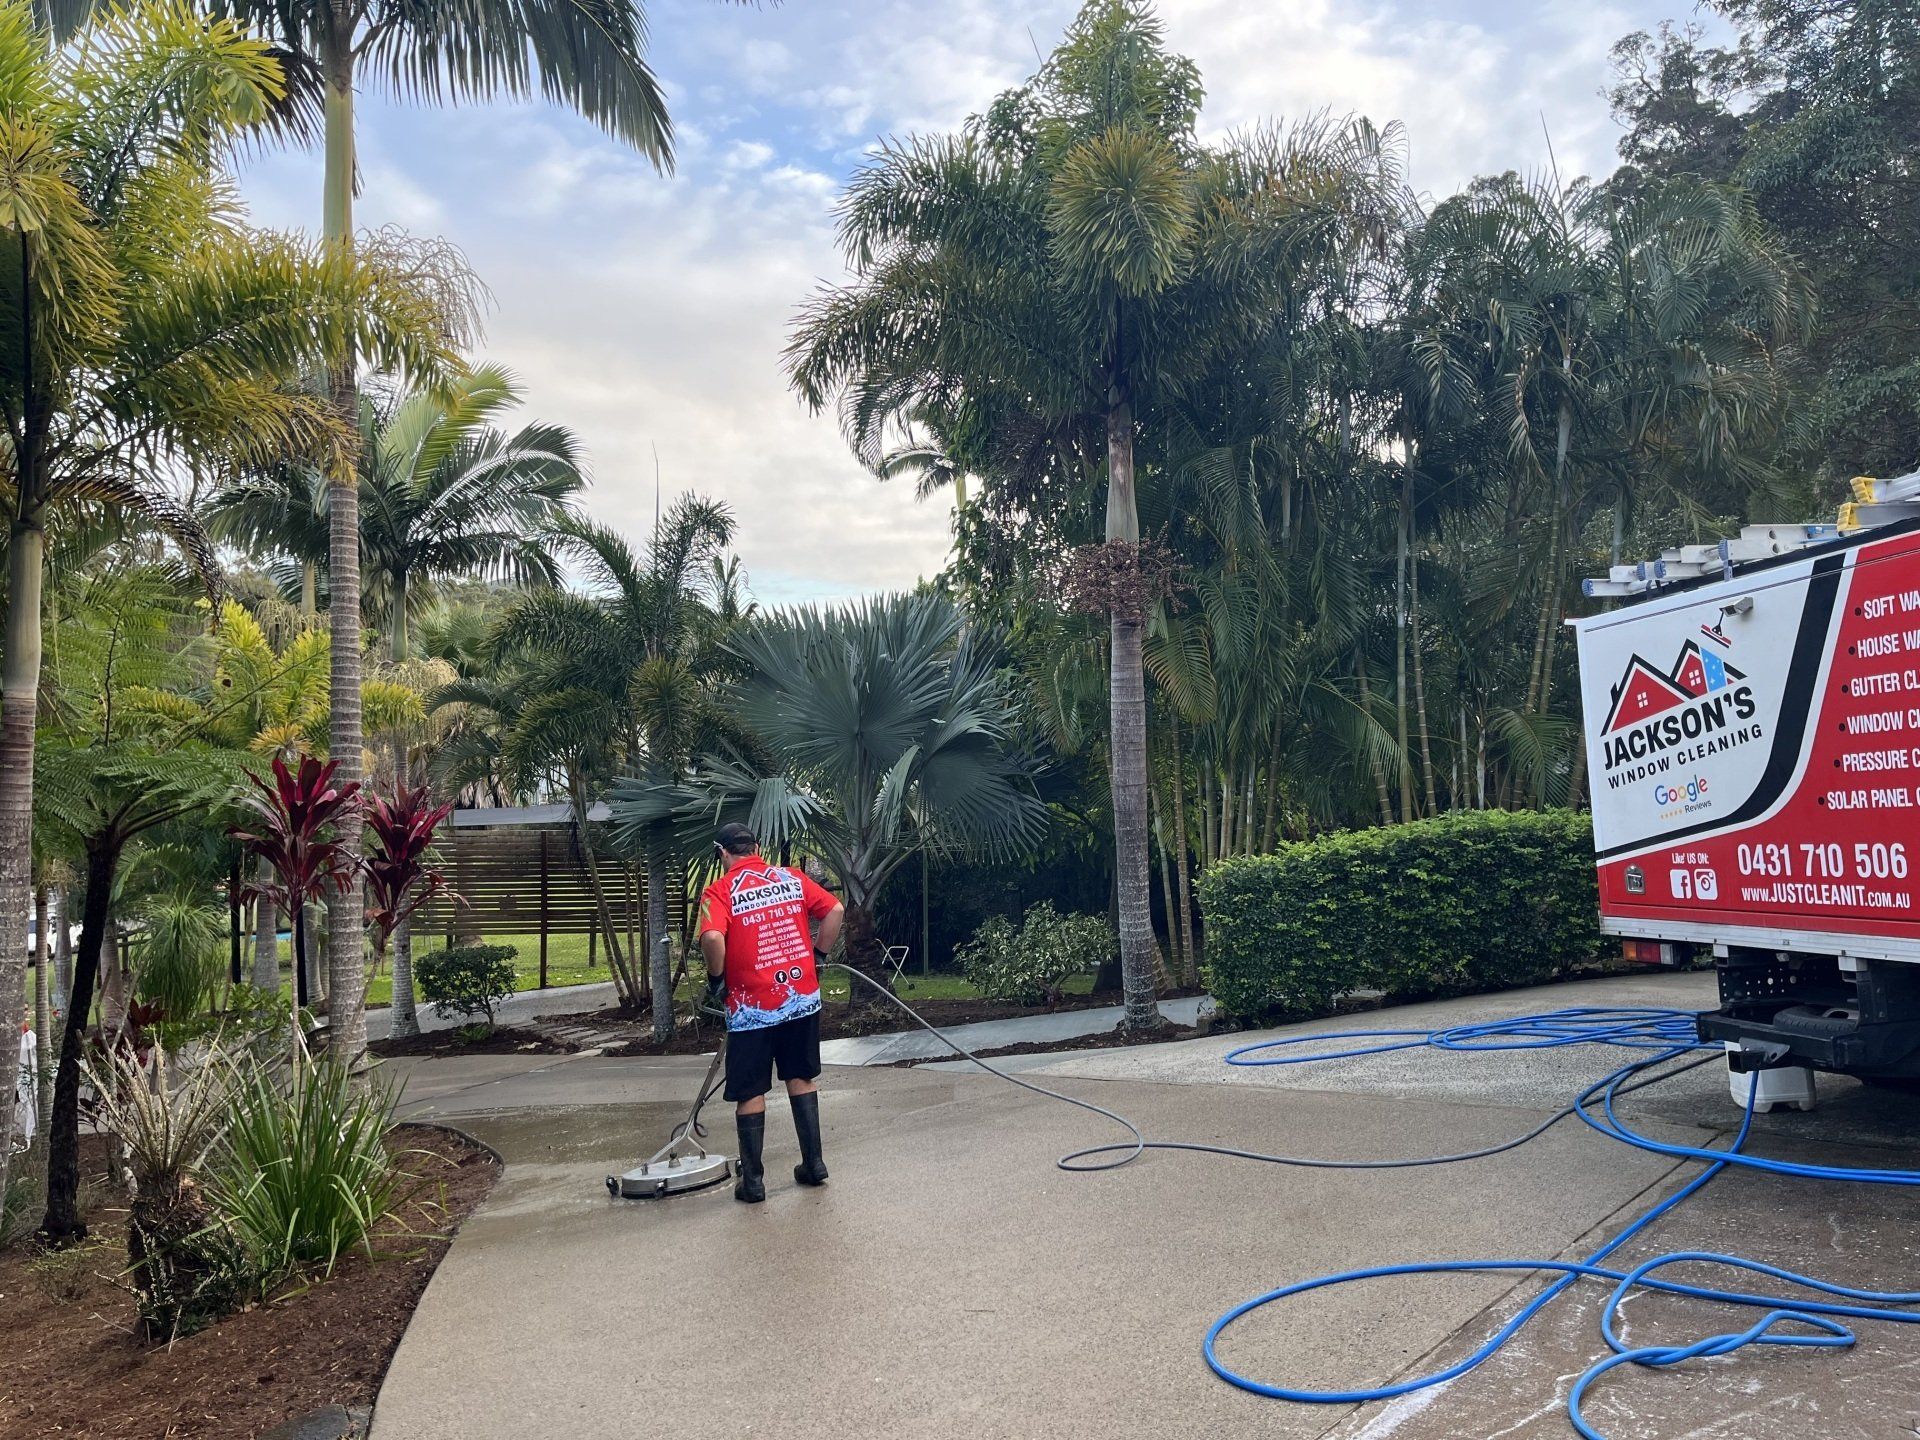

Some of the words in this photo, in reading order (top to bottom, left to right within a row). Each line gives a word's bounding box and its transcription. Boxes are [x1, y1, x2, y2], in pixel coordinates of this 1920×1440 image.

[1863, 595, 1895, 619] SOFT
[1857, 633, 1900, 658] HOUSE
[1851, 672, 1901, 697] GUTTER
[1604, 686, 1756, 770] JACKSON'S
[1846, 710, 1903, 735] WINDOW
[1608, 756, 1670, 789] WINDOW
[1677, 723, 1763, 765] CLEANING
[1842, 749, 1909, 772] PRESSURE
[1655, 774, 1708, 805] Google
[1827, 790, 1868, 810] SOLAR
[1870, 788, 1913, 808] PANEL
[1684, 800, 1712, 813] Reviews
[1686, 852, 1696, 864] US
[1737, 843, 1792, 876] 0431
[1800, 843, 1844, 878] 710
[1854, 843, 1908, 879] 506
[732, 881, 801, 906] JACKSON'S
[734, 902, 767, 914] WINDOW
[742, 912, 766, 926] 0431
[768, 907, 784, 919] 710
[758, 923, 770, 931] SOFT
[757, 937, 776, 946] GUTTER
[777, 931, 800, 941] CLEANING
[780, 938, 803, 948] CLEANING
[783, 944, 806, 955] CLEANING
[755, 961, 772, 970] SOLAR
